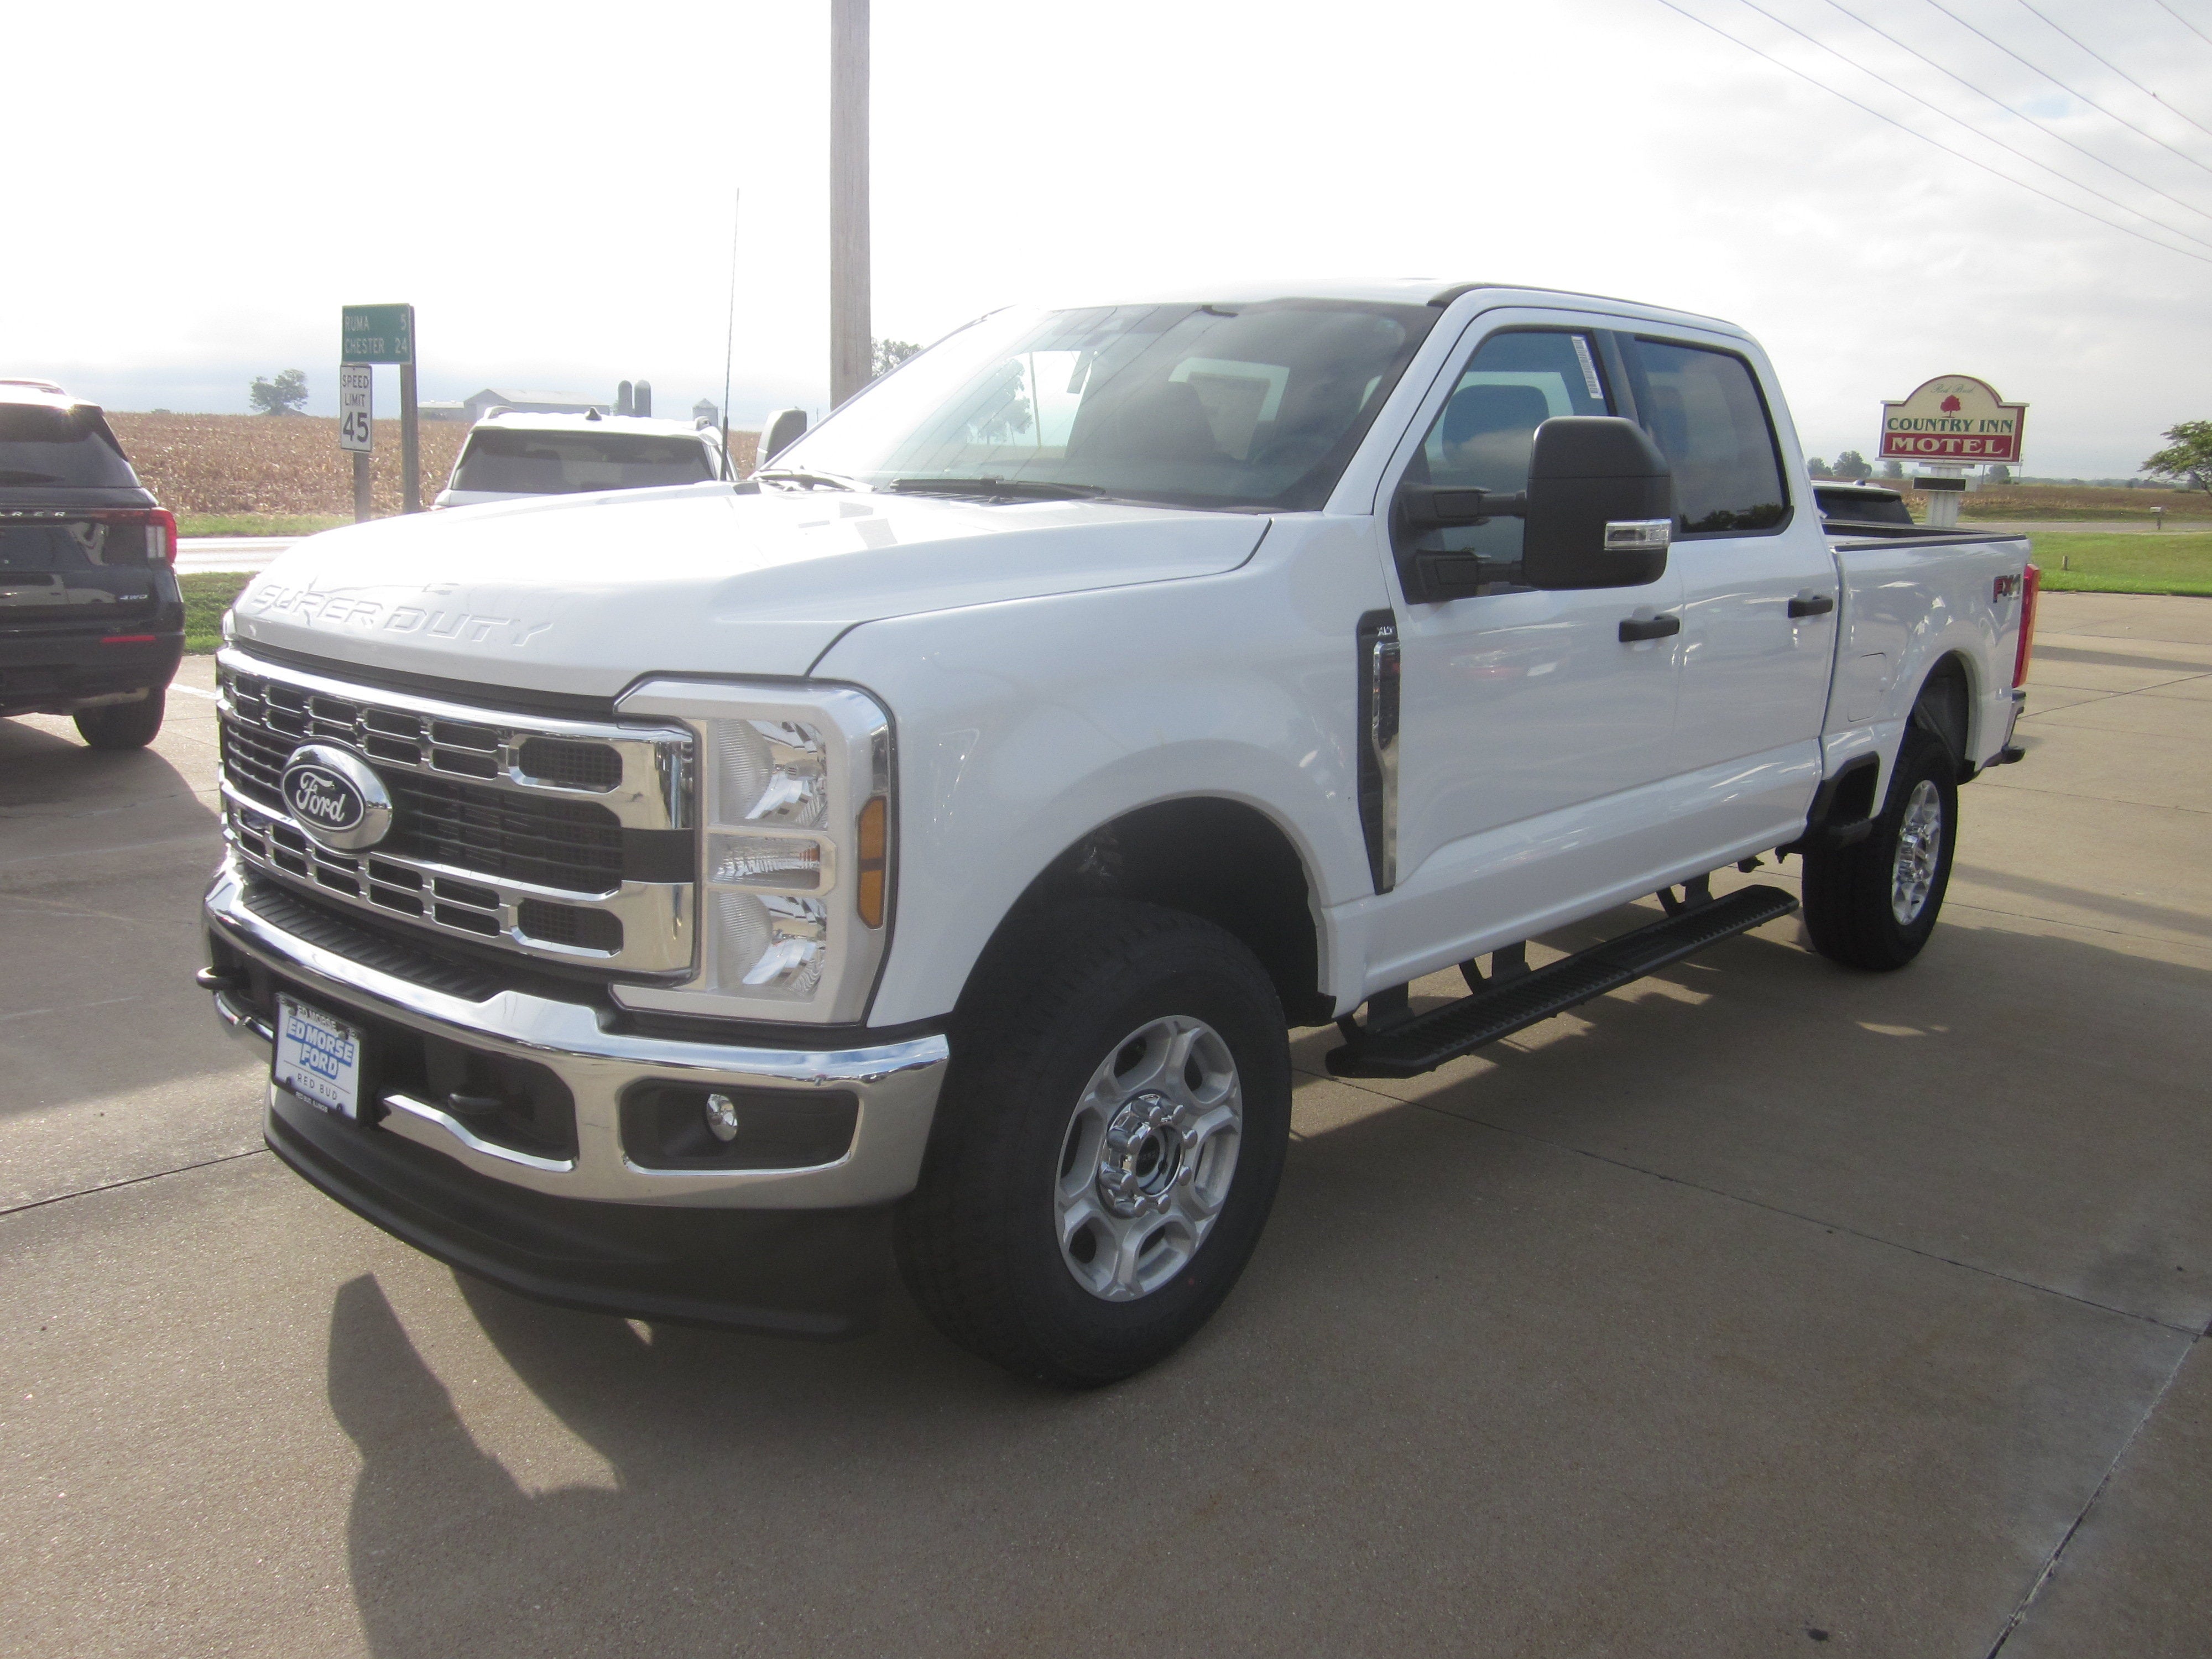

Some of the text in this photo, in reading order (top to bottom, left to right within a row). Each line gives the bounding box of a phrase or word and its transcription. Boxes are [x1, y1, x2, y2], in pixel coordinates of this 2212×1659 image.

[345, 314, 406, 331] RUMA 5
[345, 338, 408, 354] CHESTER 24
[342, 374, 369, 388] SPEED
[345, 393, 366, 407] LIMIT
[343, 412, 369, 442] 45
[1887, 418, 2013, 433] COUNTRY INN
[1890, 437, 2004, 455] MOTEL
[250, 584, 553, 646] SUPER DUTY
[296, 771, 346, 822] Ford
[287, 1016, 354, 1068] ED MORSE
[300, 1044, 340, 1079] FORD
[298, 1073, 337, 1100] RED BUD
